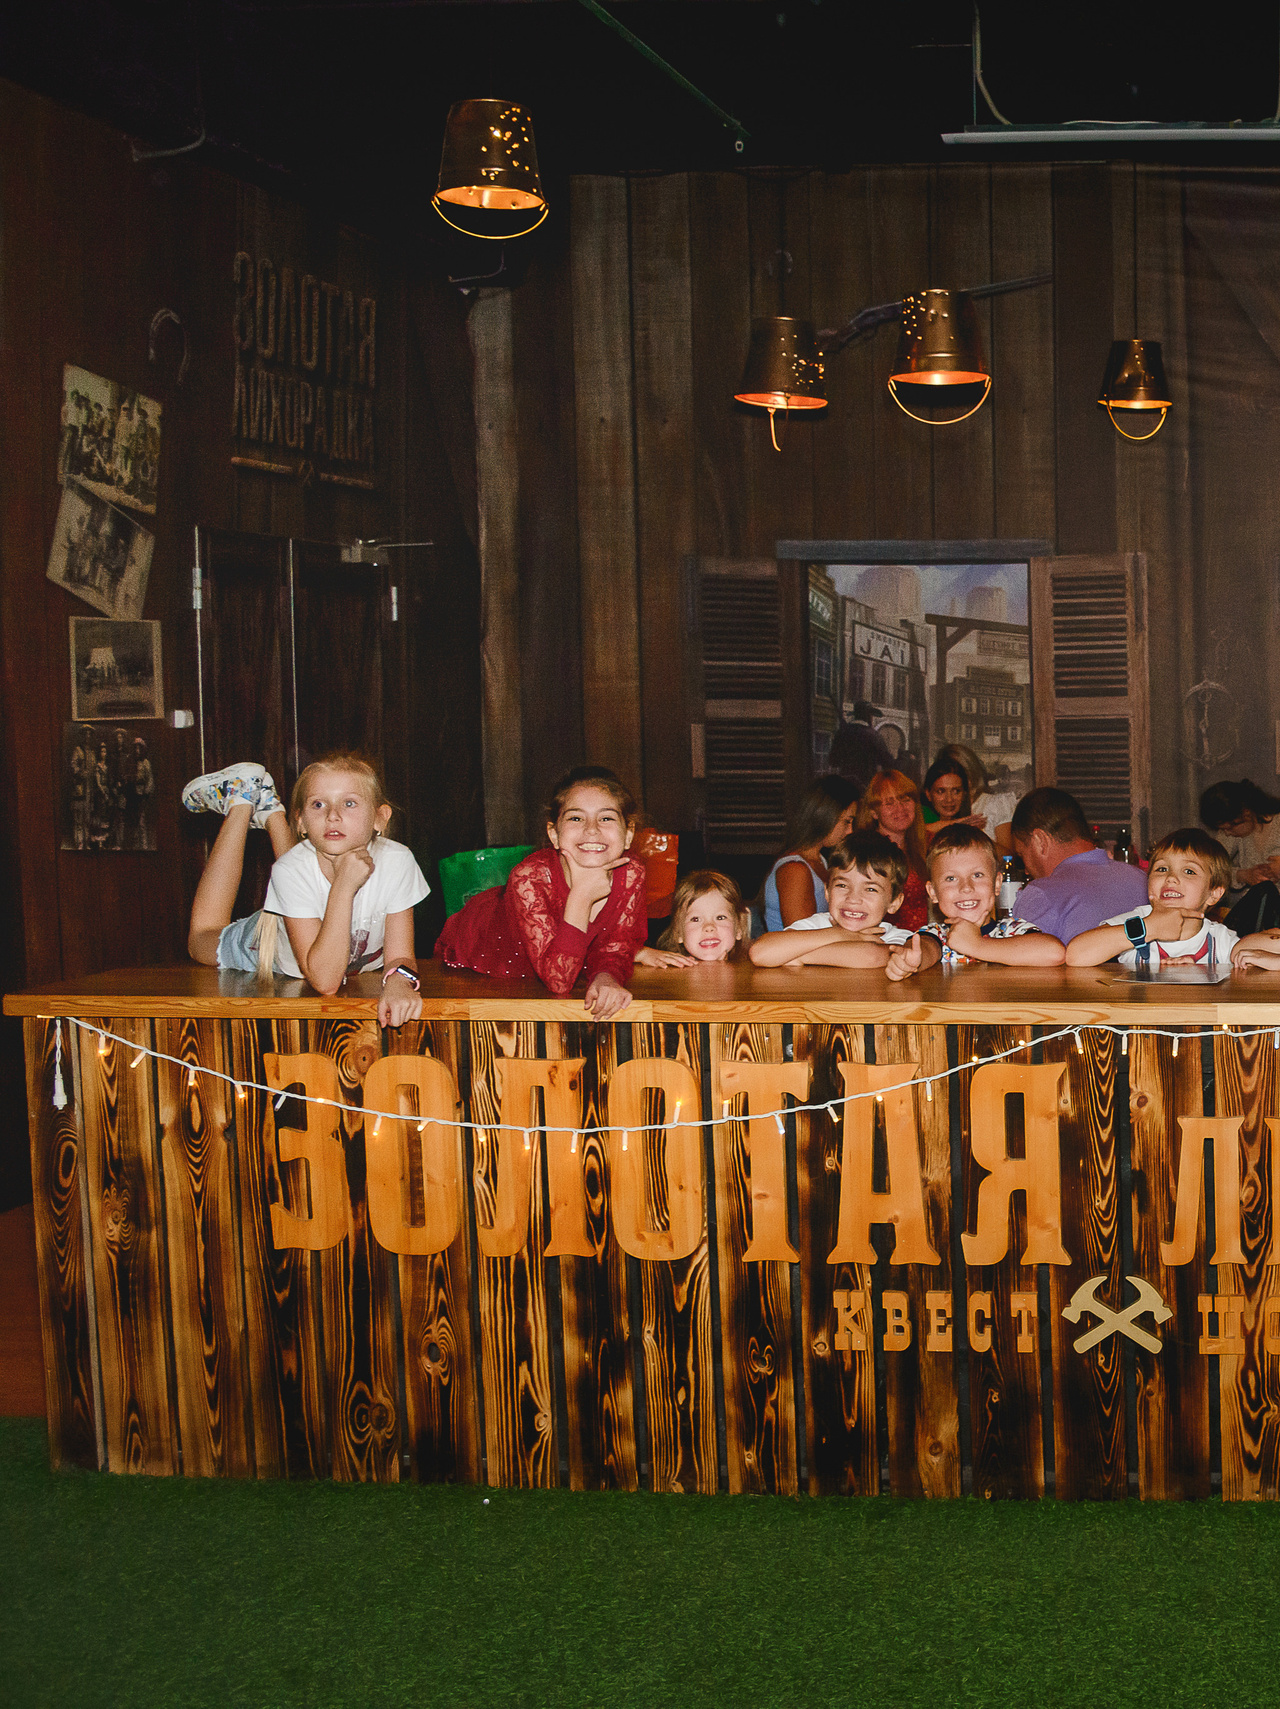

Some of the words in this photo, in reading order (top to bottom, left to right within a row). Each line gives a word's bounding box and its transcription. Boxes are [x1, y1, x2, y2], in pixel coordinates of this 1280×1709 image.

[233, 251, 376, 389] ЗОЛОТАЯ
[263, 1052, 1072, 1267] ЗОЛОТАЯ
[833, 1288, 1039, 1355] КВЕСТ
